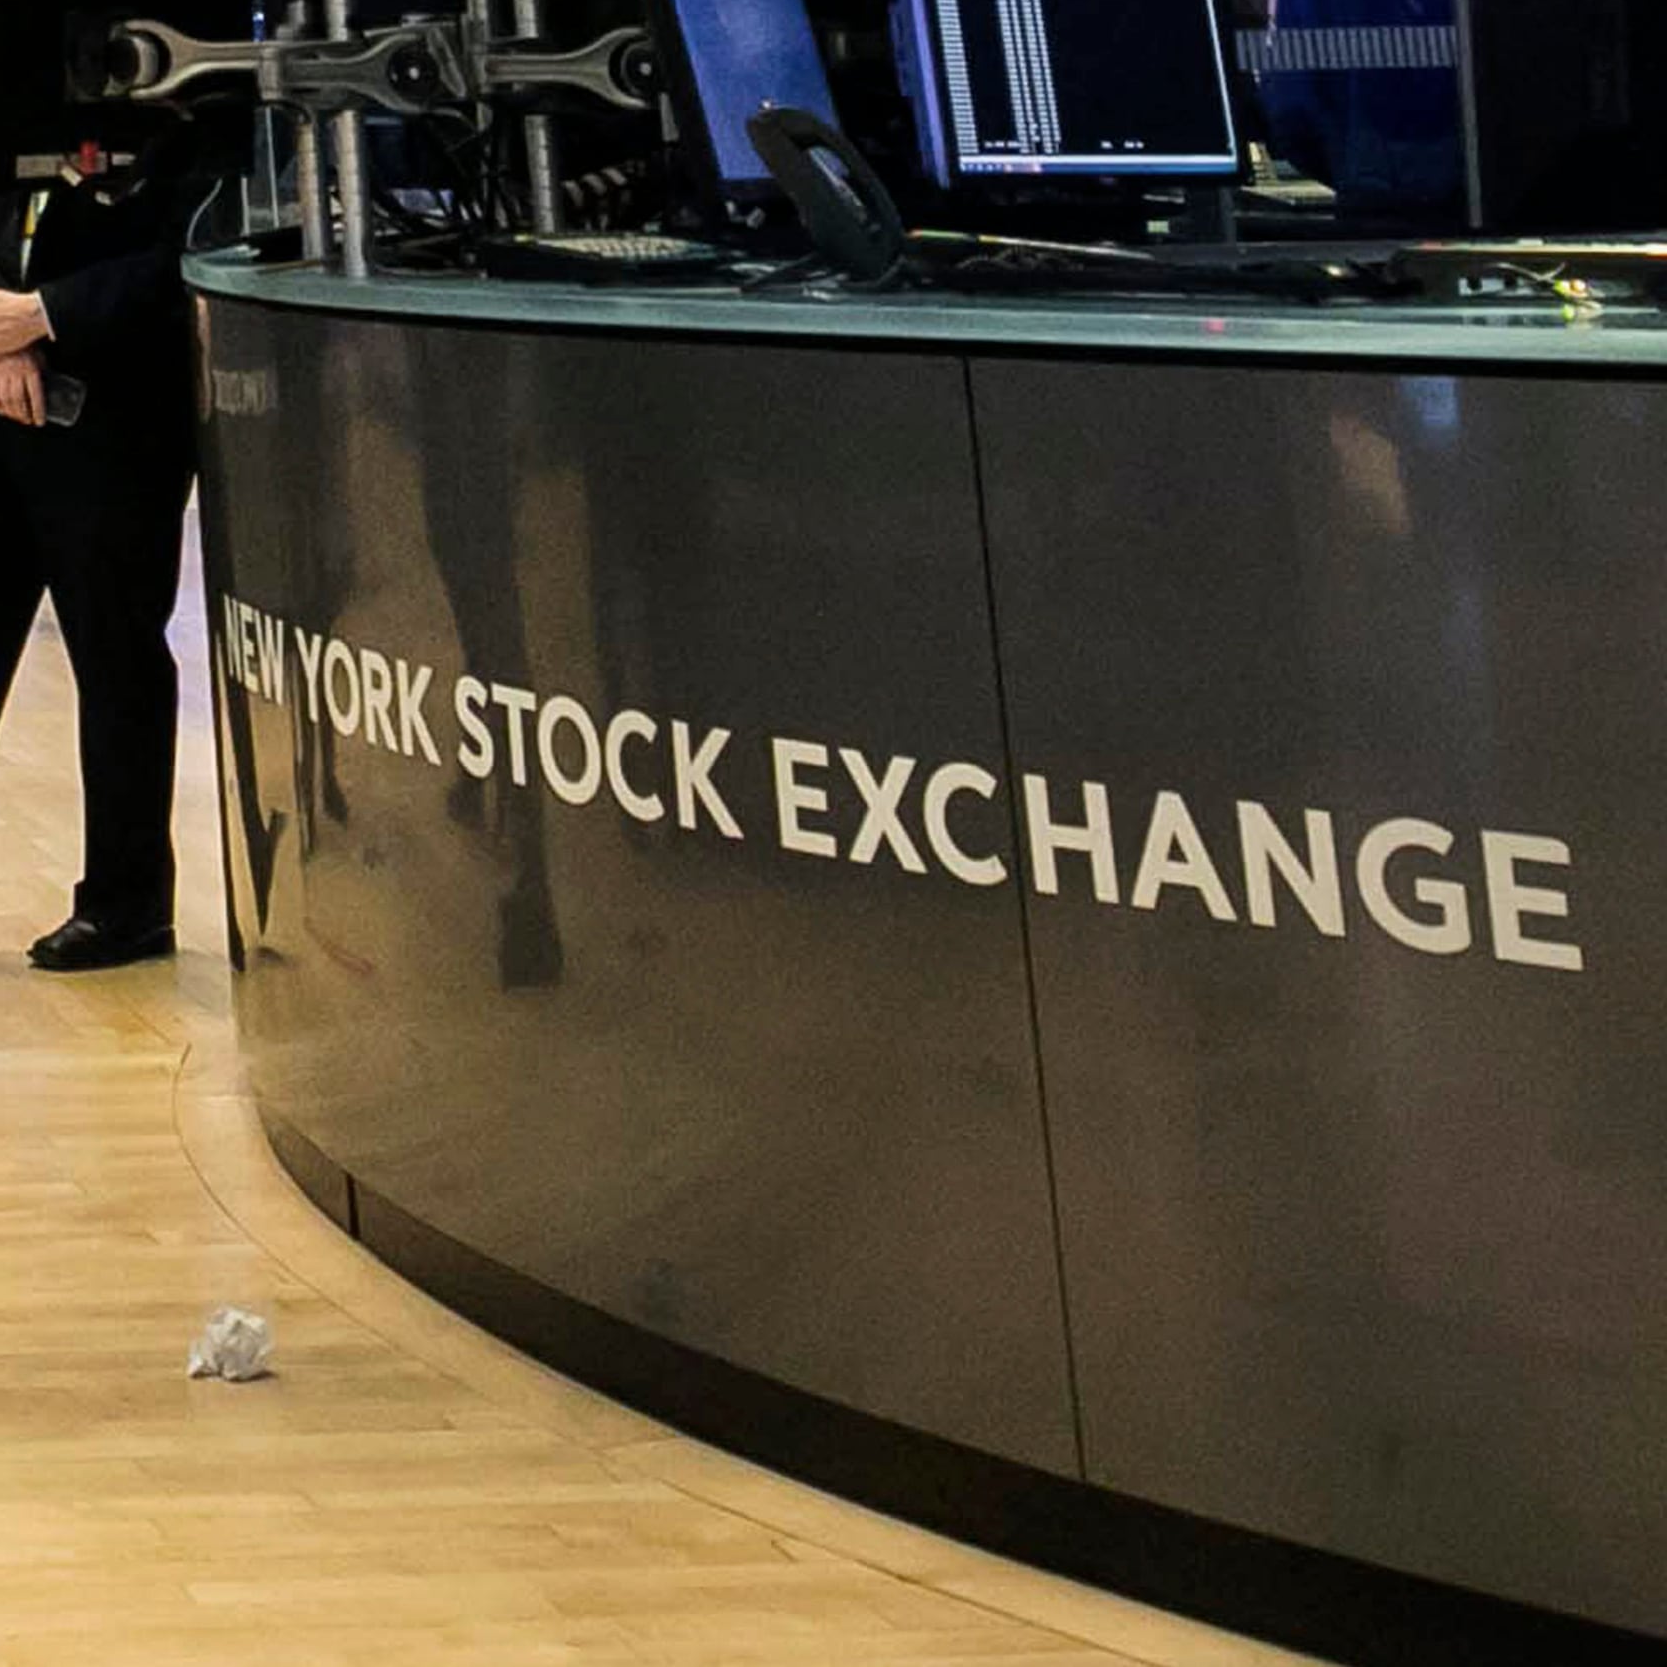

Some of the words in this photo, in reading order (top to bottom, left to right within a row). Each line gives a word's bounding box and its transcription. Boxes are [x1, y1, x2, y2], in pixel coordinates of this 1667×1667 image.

[223, 594, 286, 707] NEW
[292, 627, 442, 768] YORK
[455, 674, 746, 842] STOCK
[770, 736, 1585, 972] EXCHANGE
